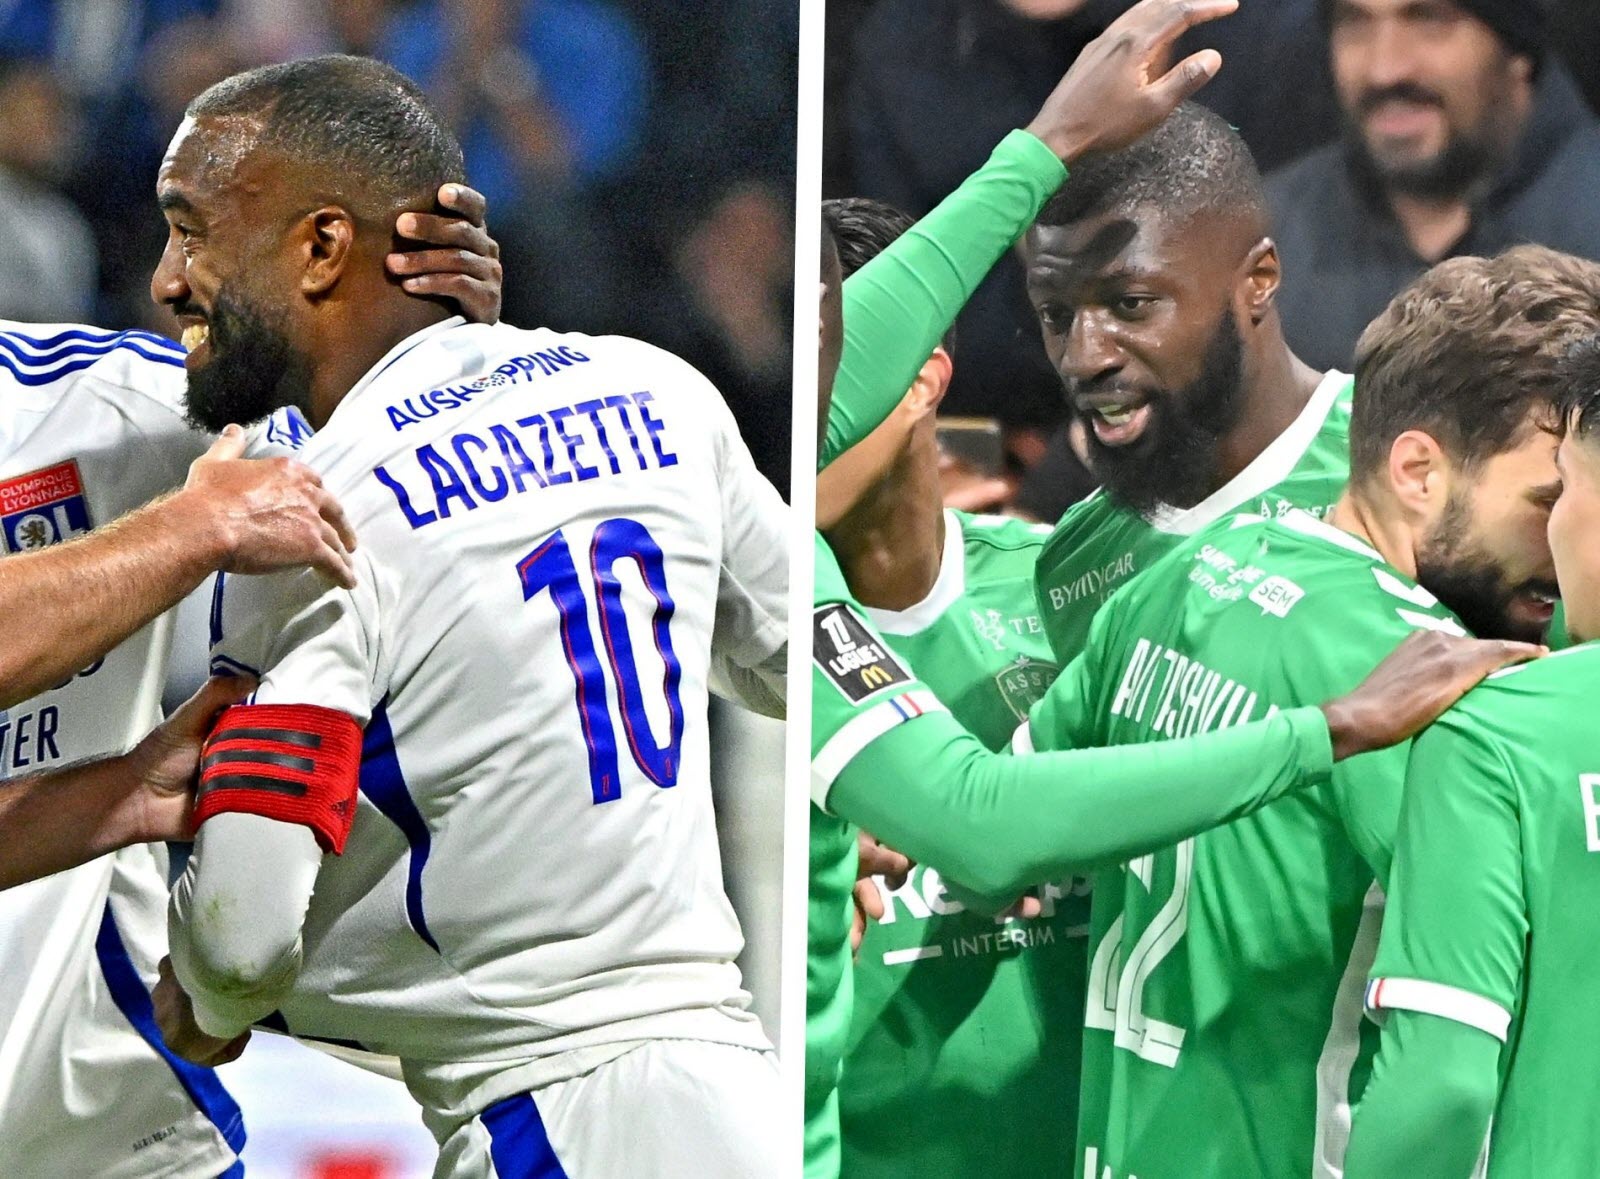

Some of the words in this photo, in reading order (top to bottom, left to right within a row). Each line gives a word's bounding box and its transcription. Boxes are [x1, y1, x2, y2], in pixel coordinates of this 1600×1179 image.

[373, 391, 678, 529] LACAZETTE
[0, 469, 72, 498] OLYMPIQUE
[4, 481, 75, 512] LYONNAIS
[1049, 553, 1134, 610] BYMYCAR
[1258, 584, 1295, 608] SEM
[1009, 616, 1045, 635] TE
[516, 518, 684, 804] 10
[953, 926, 1056, 957] INTERIM
